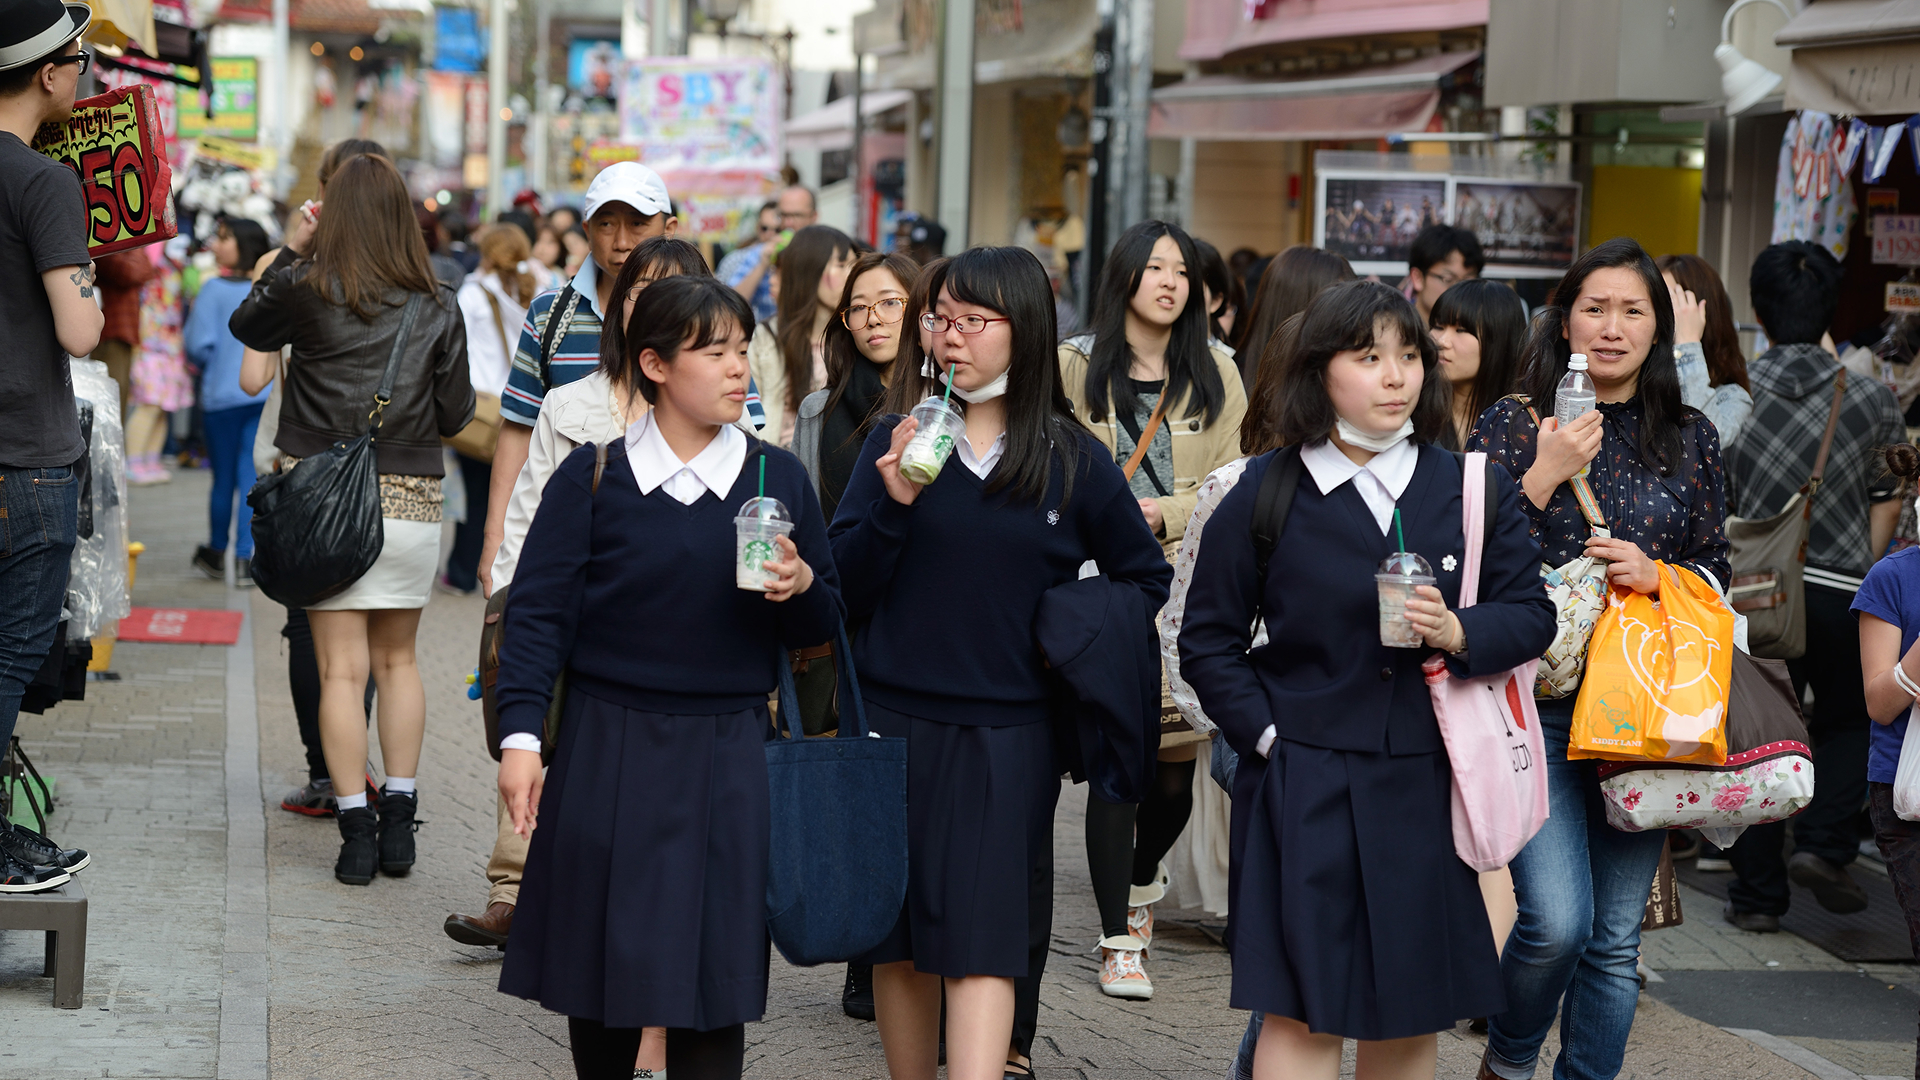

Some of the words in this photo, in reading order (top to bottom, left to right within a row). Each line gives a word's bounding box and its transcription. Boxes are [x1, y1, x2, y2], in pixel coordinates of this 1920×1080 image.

[657, 73, 743, 104] SBY
[60, 141, 151, 244] 50
[1885, 217, 1920, 233] SAL
[1591, 737, 1619, 746] KIDDY
[1653, 904, 1664, 924] BIC
